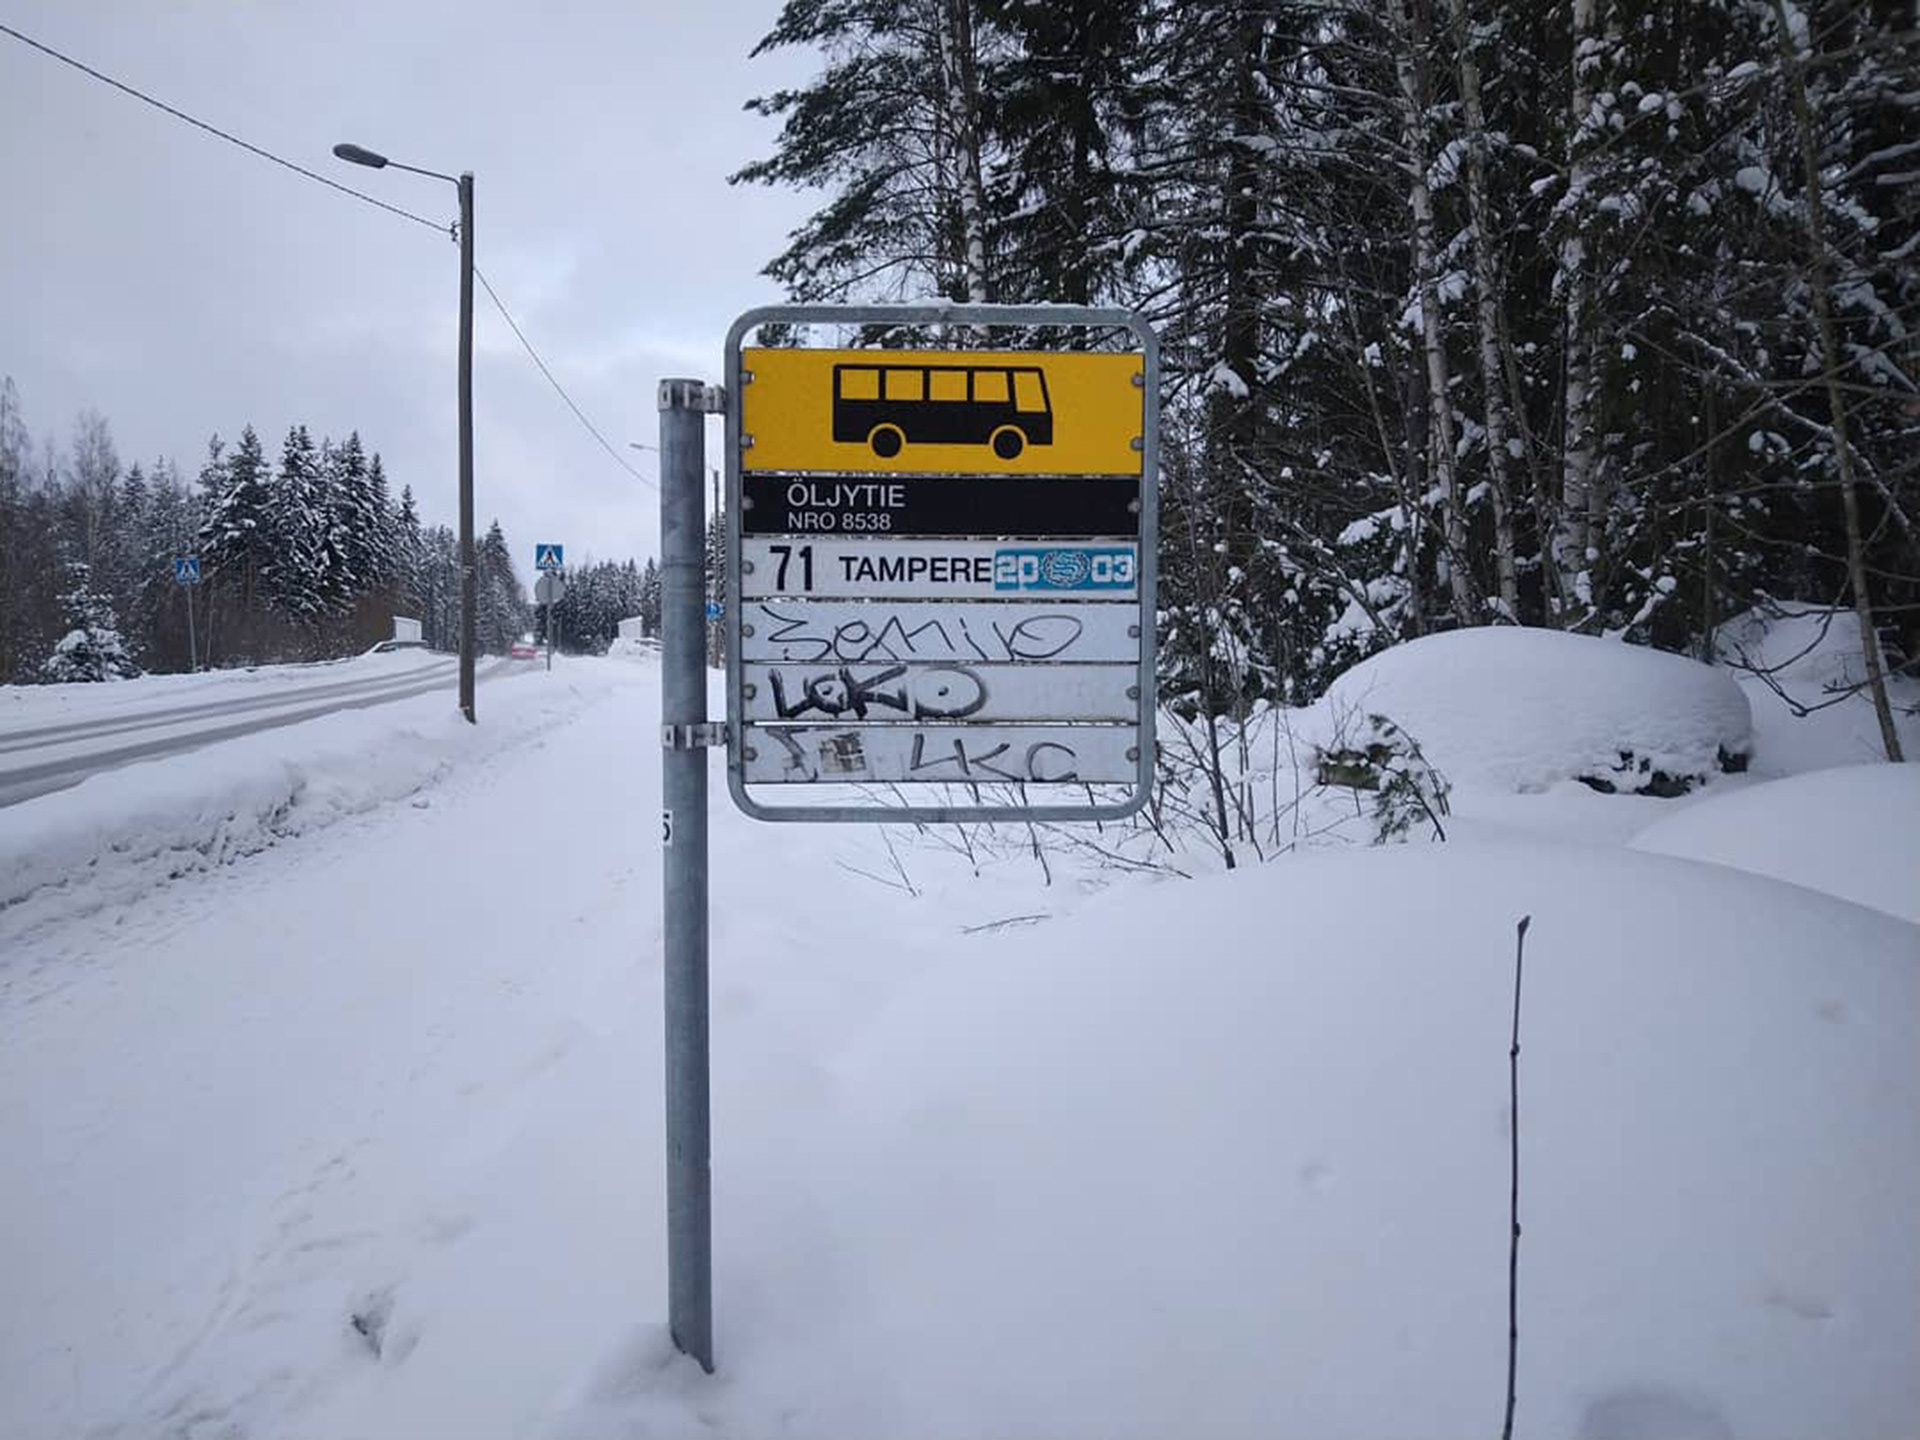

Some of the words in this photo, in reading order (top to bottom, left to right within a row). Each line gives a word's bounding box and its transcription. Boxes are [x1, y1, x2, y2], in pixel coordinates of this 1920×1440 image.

[787, 479, 906, 507] ÖLJYTIE
[787, 512, 836, 530] NRO
[841, 512, 892, 531] 8538
[769, 545, 814, 592] 71
[838, 556, 992, 583] TAMPERE
